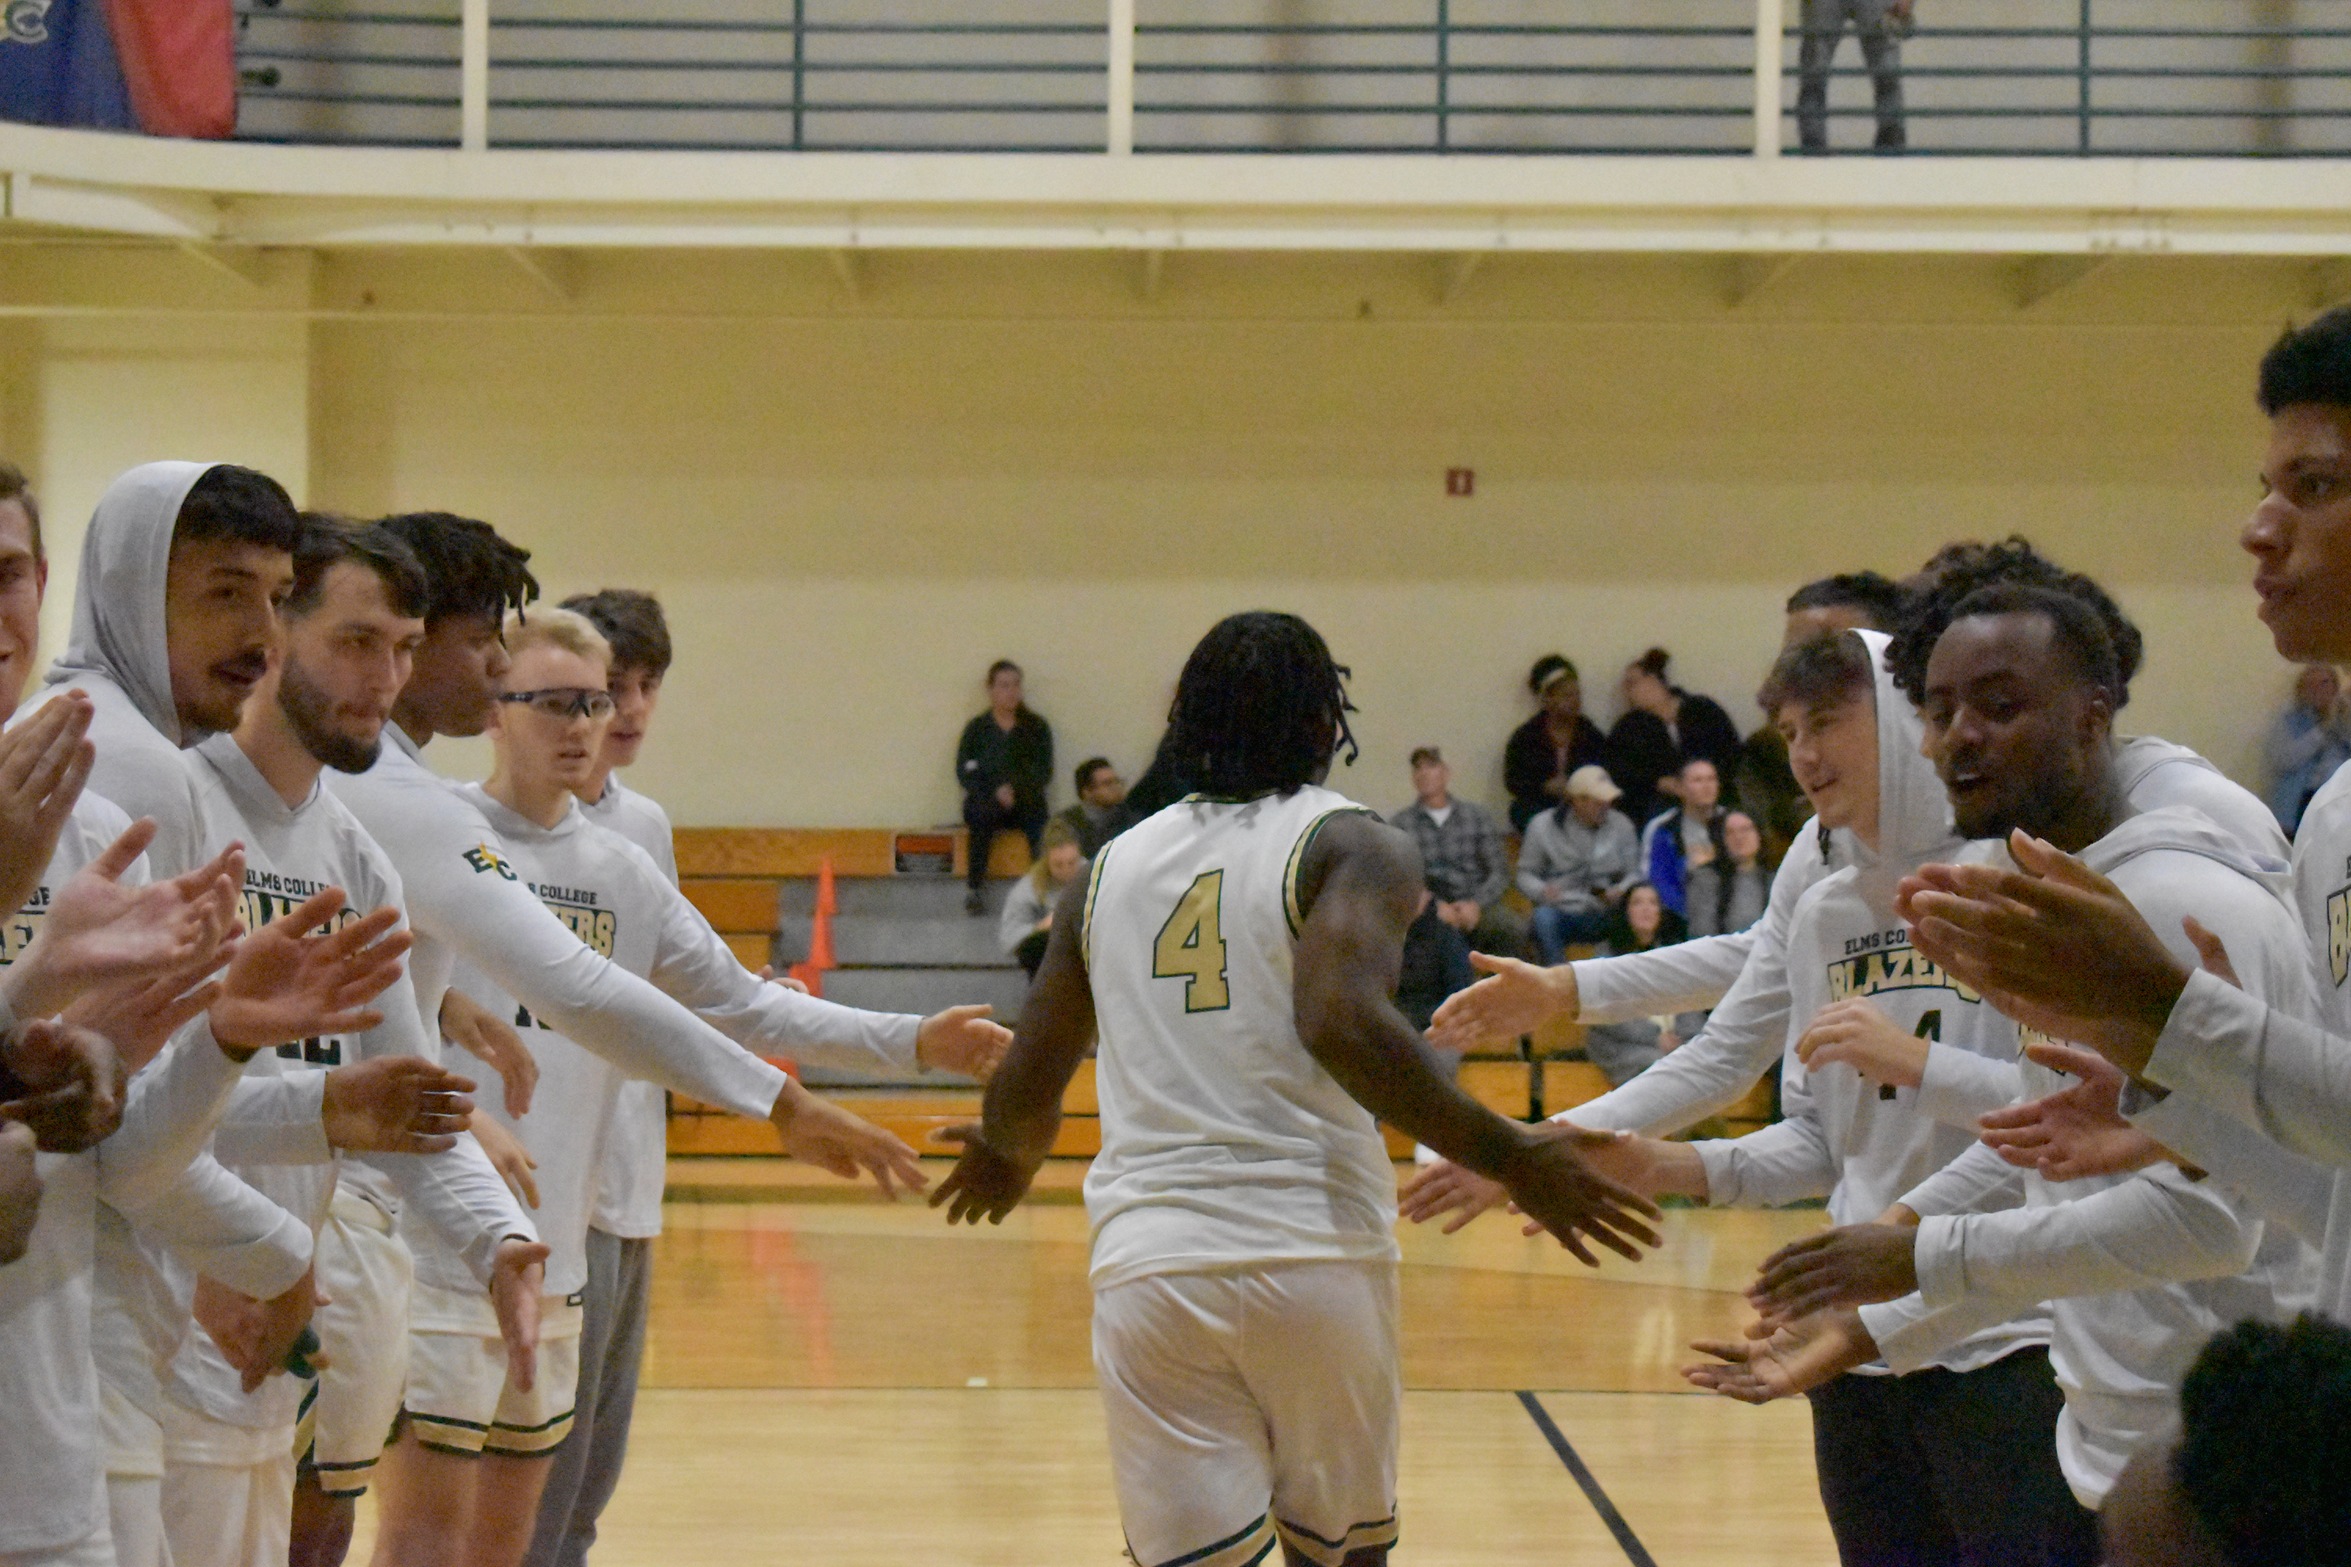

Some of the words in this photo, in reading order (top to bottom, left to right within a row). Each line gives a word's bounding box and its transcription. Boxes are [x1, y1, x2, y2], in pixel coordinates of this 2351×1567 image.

[540, 884, 598, 905] COLLEGE
[1152, 868, 1230, 1014] 4
[1844, 934, 1880, 955] ELMS
[1827, 945, 1982, 1005] BLAZE
